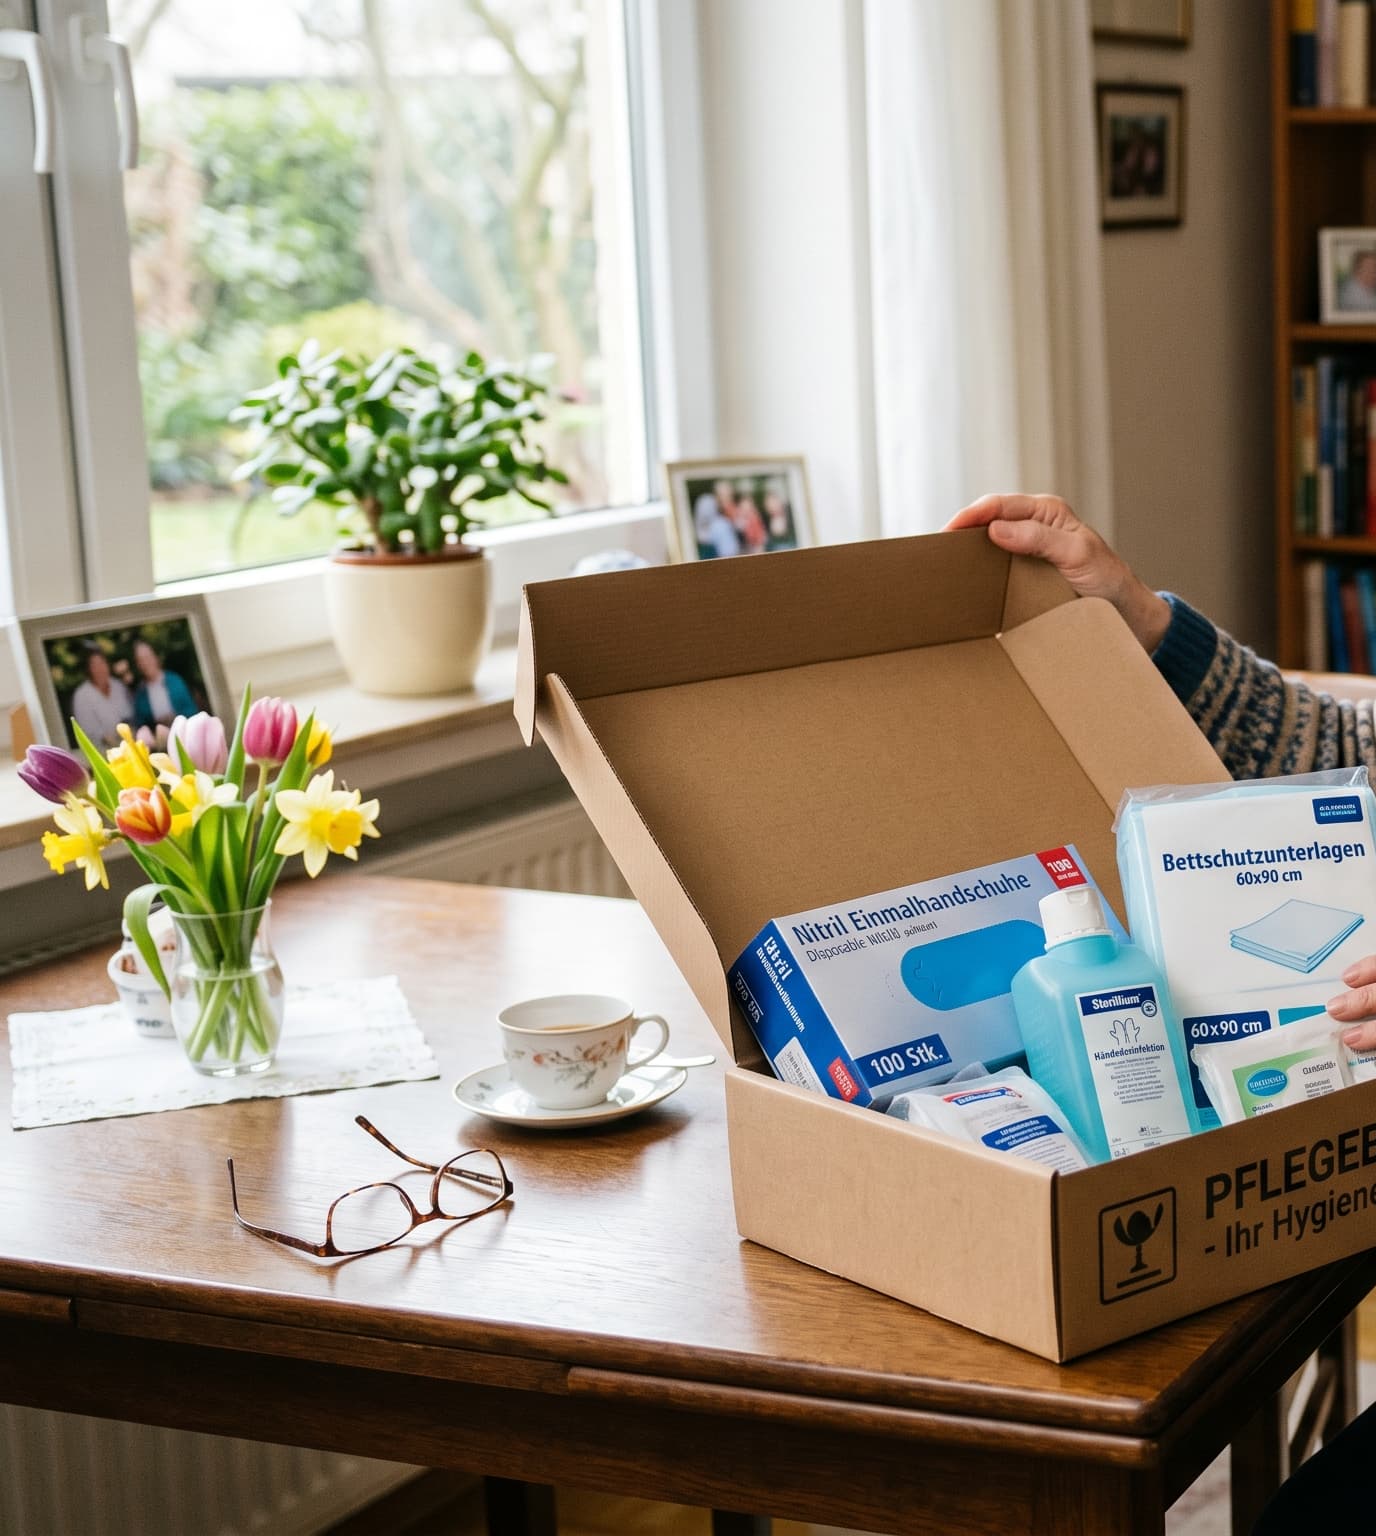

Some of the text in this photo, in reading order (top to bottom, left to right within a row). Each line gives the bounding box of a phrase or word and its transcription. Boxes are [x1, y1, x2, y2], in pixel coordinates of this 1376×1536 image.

[1162, 842, 1366, 872] Bettschutzunterlagen
[1236, 869, 1303, 886] 60x90 cm
[792, 914, 848, 945] Nitril
[848, 873, 1031, 932] Einmalhandschuhe
[1242, 1021, 1263, 1033] cm
[870, 1042, 943, 1077] 100 Stk.
[1226, 1220, 1264, 1258] Ihr
